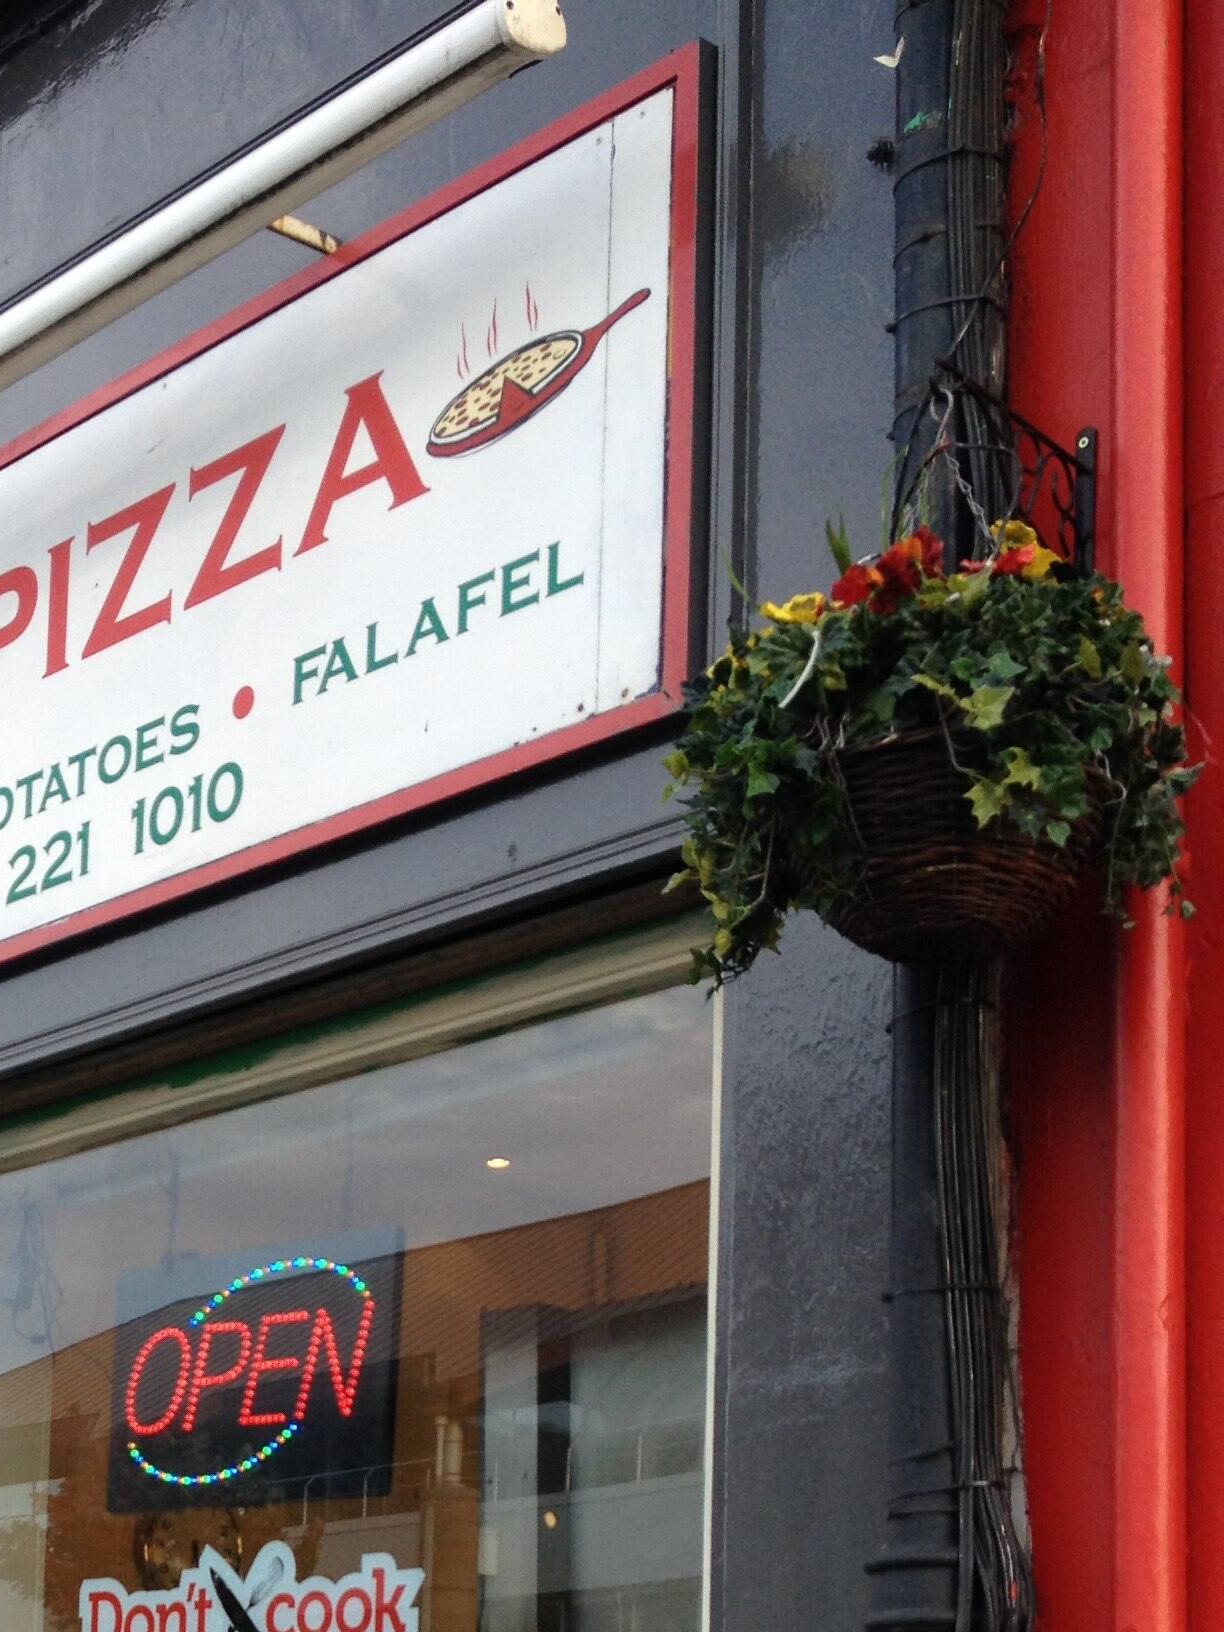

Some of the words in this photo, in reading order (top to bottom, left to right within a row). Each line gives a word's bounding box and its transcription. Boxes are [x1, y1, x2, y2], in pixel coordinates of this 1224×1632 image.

[291, 540, 585, 706] FALAFEL
[5, 822, 92, 904] 221
[132, 761, 244, 856] 1010
[127, 1298, 375, 1437] OPEN
